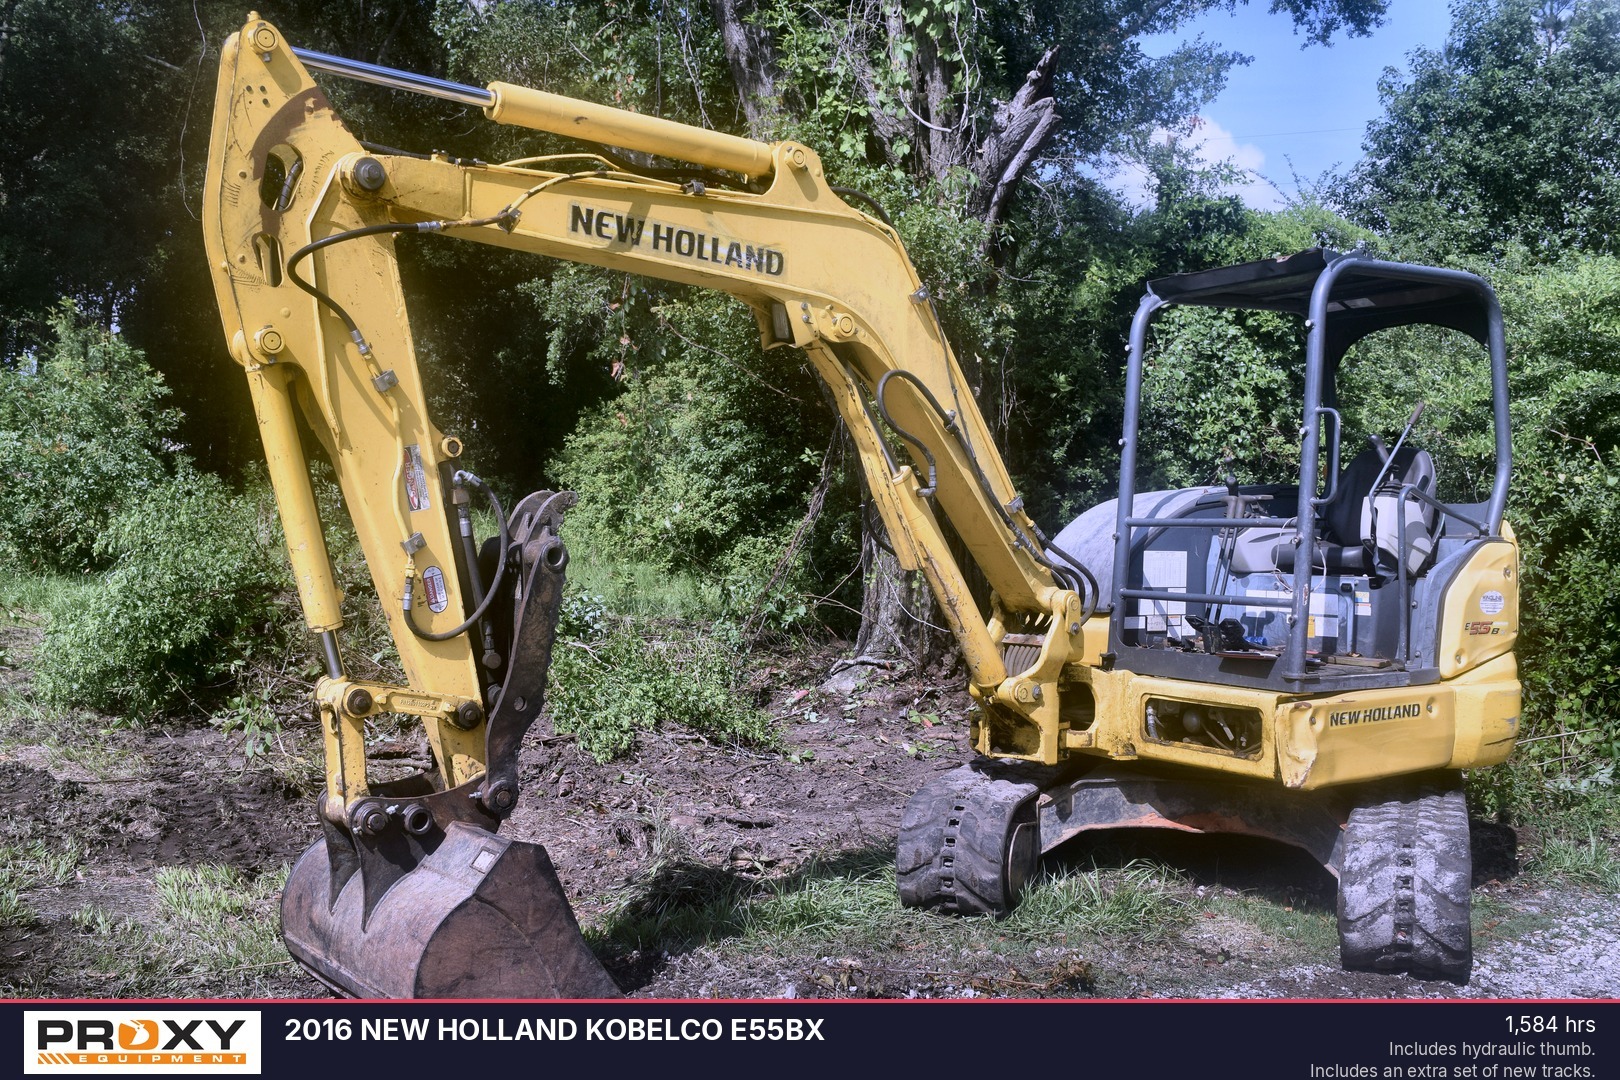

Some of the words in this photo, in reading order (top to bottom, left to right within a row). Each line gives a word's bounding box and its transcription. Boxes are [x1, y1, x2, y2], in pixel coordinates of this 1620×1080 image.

[571, 205, 645, 246] NEW
[652, 223, 785, 277] HOLLAND
[1330, 710, 1361, 727] NEW
[1362, 703, 1421, 723] HOLLAND
